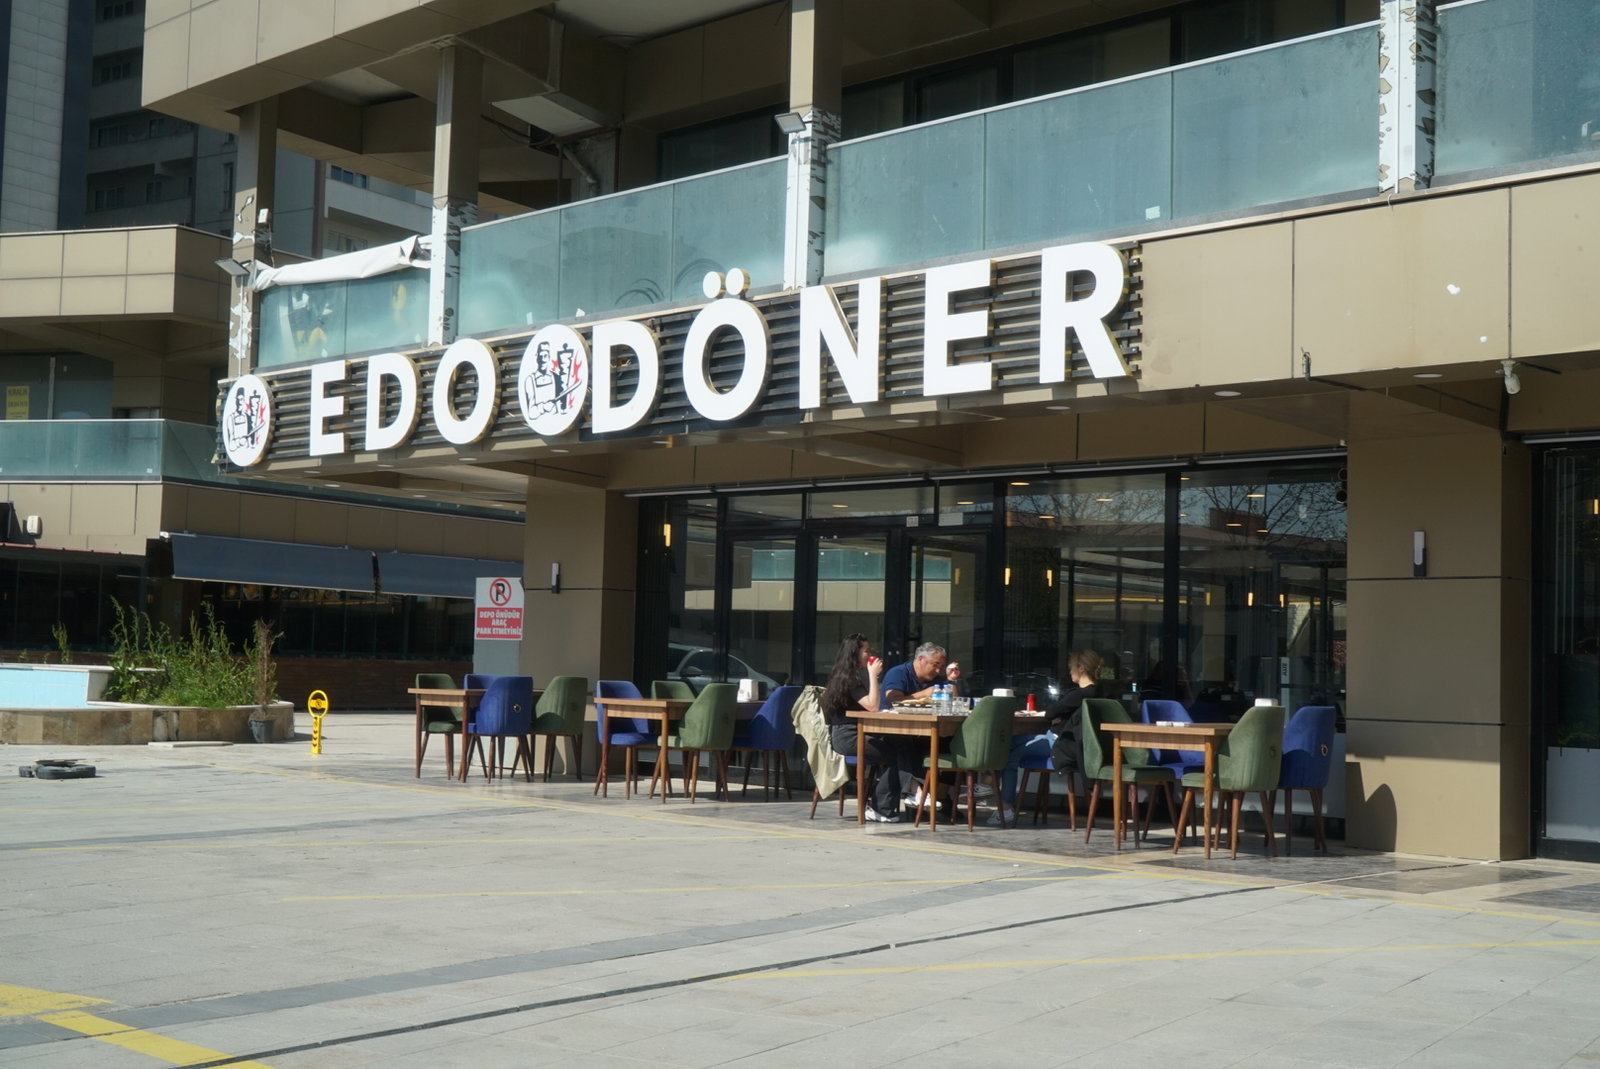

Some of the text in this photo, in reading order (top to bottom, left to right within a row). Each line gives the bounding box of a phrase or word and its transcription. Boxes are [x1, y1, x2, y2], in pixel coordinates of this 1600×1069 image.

[309, 241, 1131, 457] EDO DÖNER
[491, 619, 508, 628] ARAÇ
